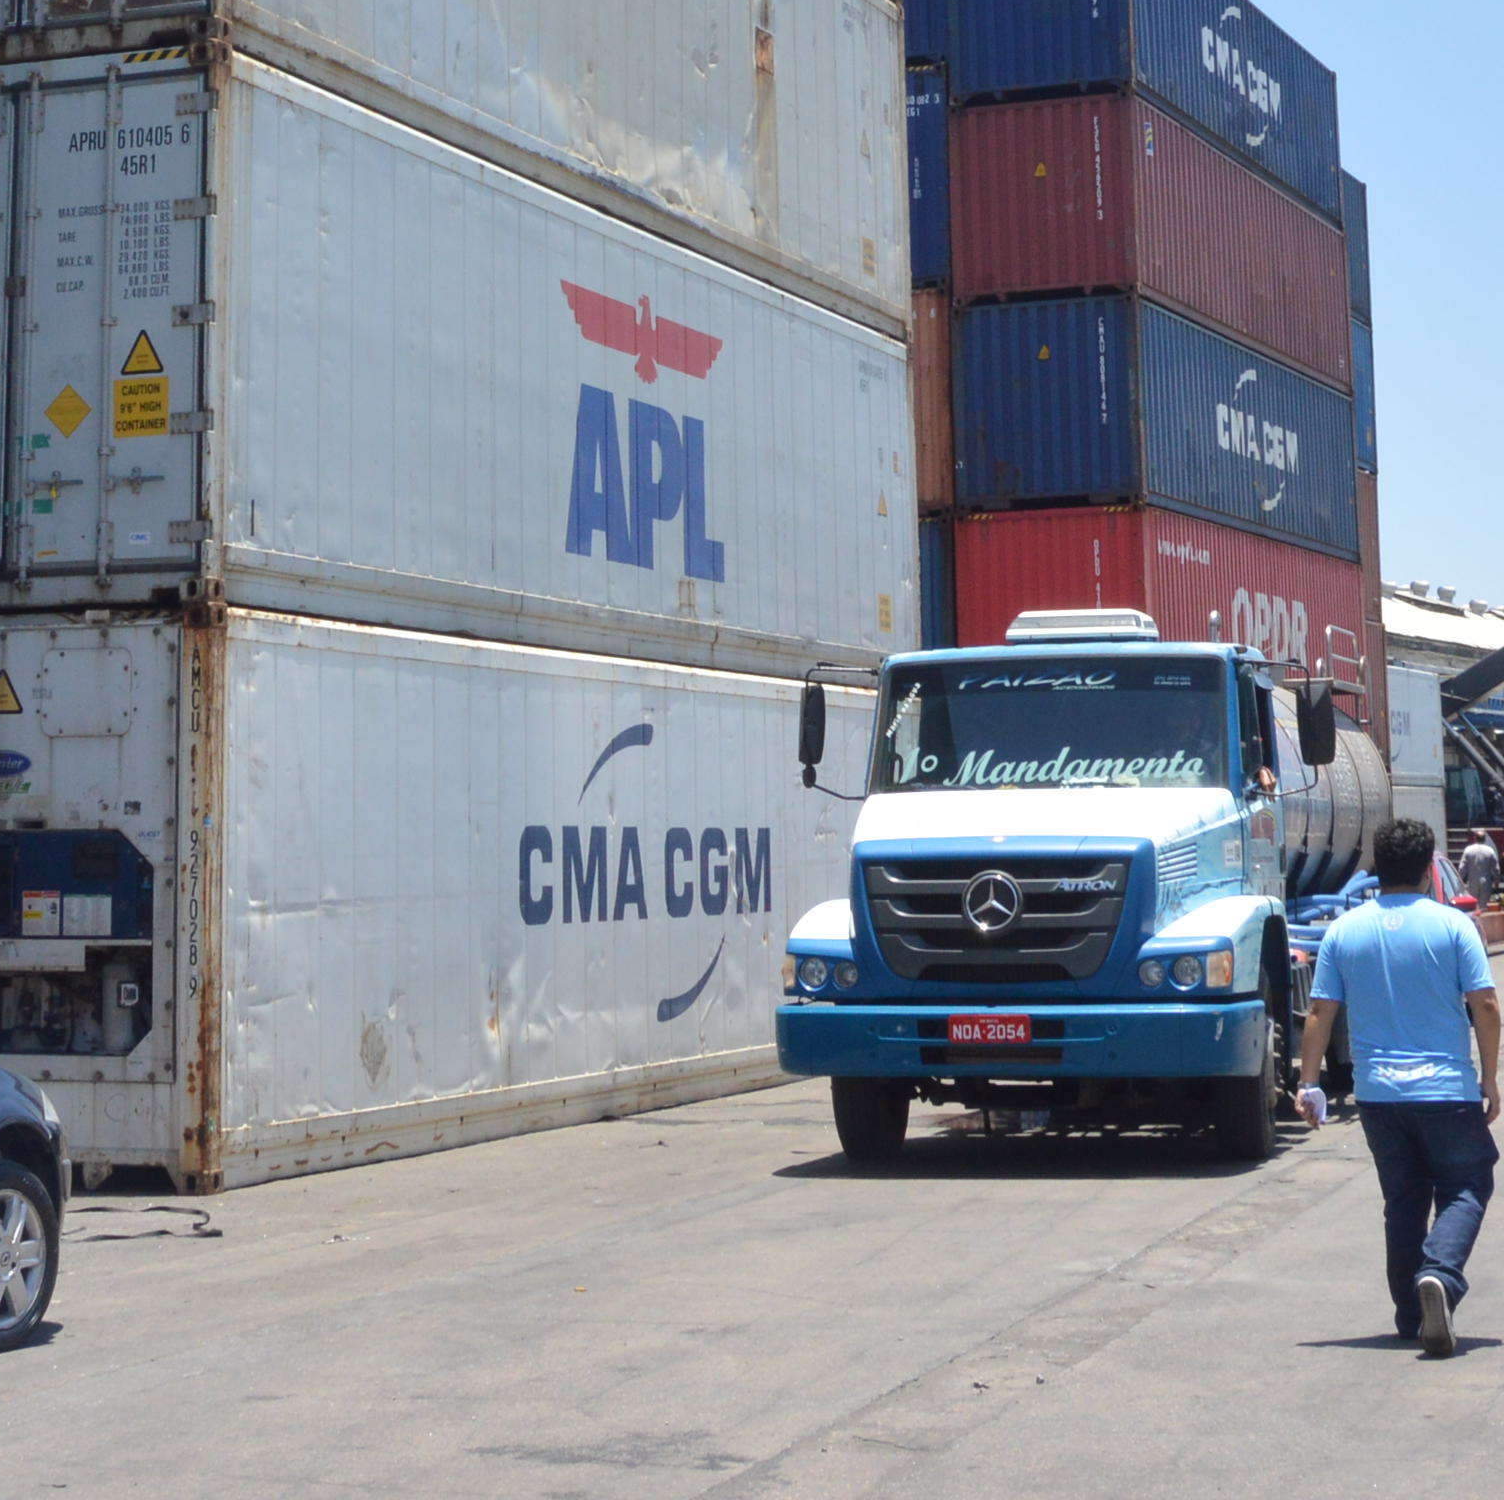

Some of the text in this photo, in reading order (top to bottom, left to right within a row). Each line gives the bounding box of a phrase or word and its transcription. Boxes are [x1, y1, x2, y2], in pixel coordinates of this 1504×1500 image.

[1201, 25, 1282, 124] CMA CGM
[68, 123, 190, 153] APRU 610405 6
[120, 154, 156, 176] 45R1
[58, 232, 76, 243] TARE
[122, 383, 160, 396] CAUTION
[140, 399, 161, 412] HIGH
[116, 417, 166, 432] CONTAINER
[1216, 403, 1299, 476] CMA CGM
[565, 383, 725, 583] APL
[190, 647, 201, 733] AMCU
[943, 746, 1205, 787] Mandamento
[518, 825, 771, 925] CMA CGM
[1052, 877, 1117, 892] ATRON
